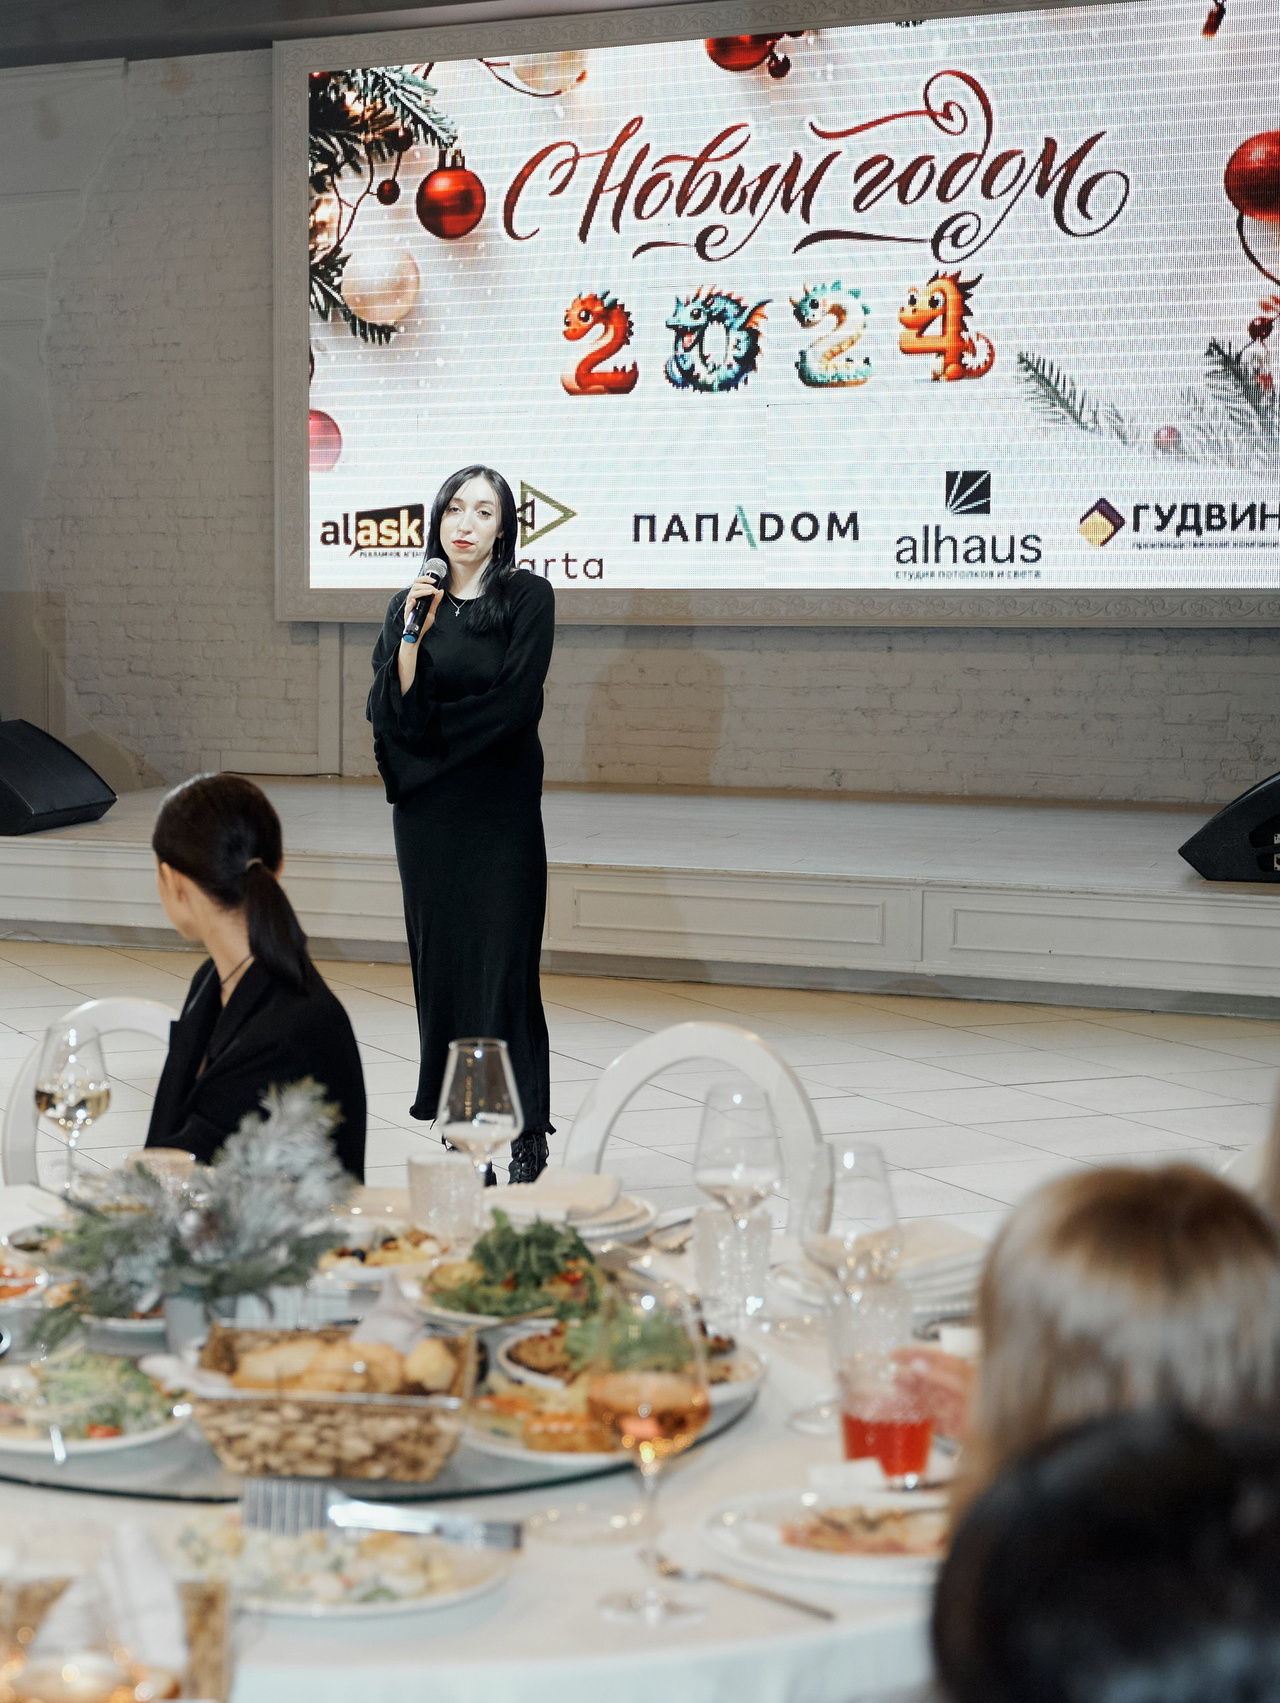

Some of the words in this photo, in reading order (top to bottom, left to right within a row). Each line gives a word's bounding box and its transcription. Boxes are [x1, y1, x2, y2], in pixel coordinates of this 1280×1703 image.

[550, 115, 841, 262] Новым
[793, 70, 1130, 263] годом
[560, 269, 996, 396] 2024
[320, 509, 431, 546] alask
[1133, 501, 1280, 538] ГУДВИН
[896, 524, 1042, 564] alhaus
